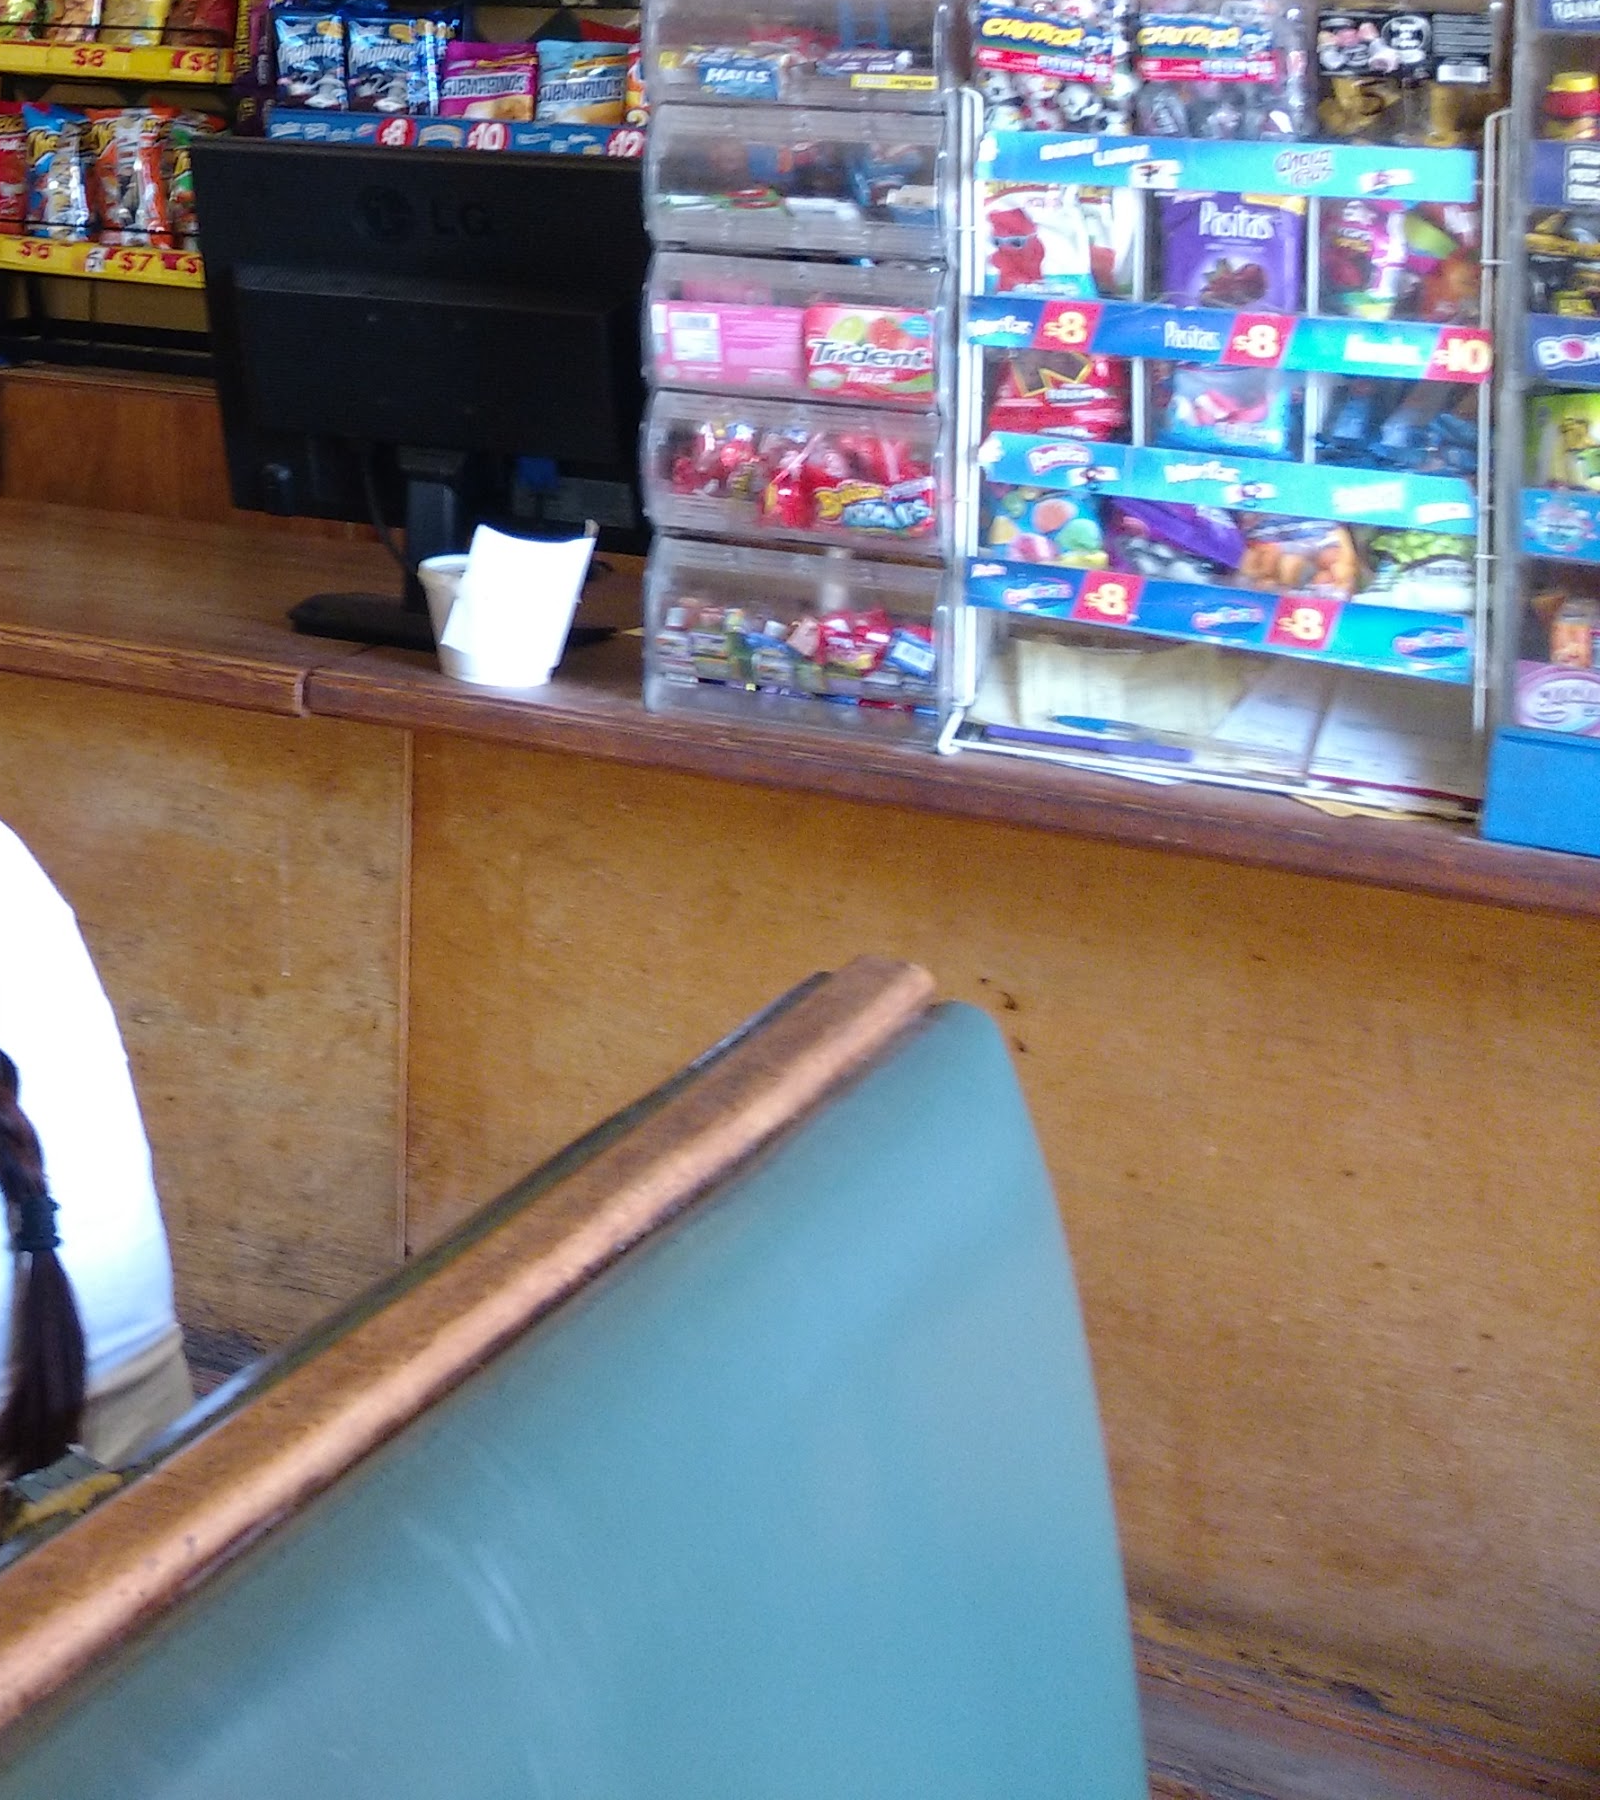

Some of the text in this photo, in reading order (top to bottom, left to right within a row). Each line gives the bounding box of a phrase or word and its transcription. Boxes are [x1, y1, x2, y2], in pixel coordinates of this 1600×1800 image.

[72, 48, 106, 68] $8
[705, 67, 770, 84] HALLS
[430, 197, 496, 237] LG
[1198, 201, 1274, 240] Pasitas
[17, 240, 51, 261] $6
[118, 252, 155, 273] $7
[809, 339, 928, 368] Trident
